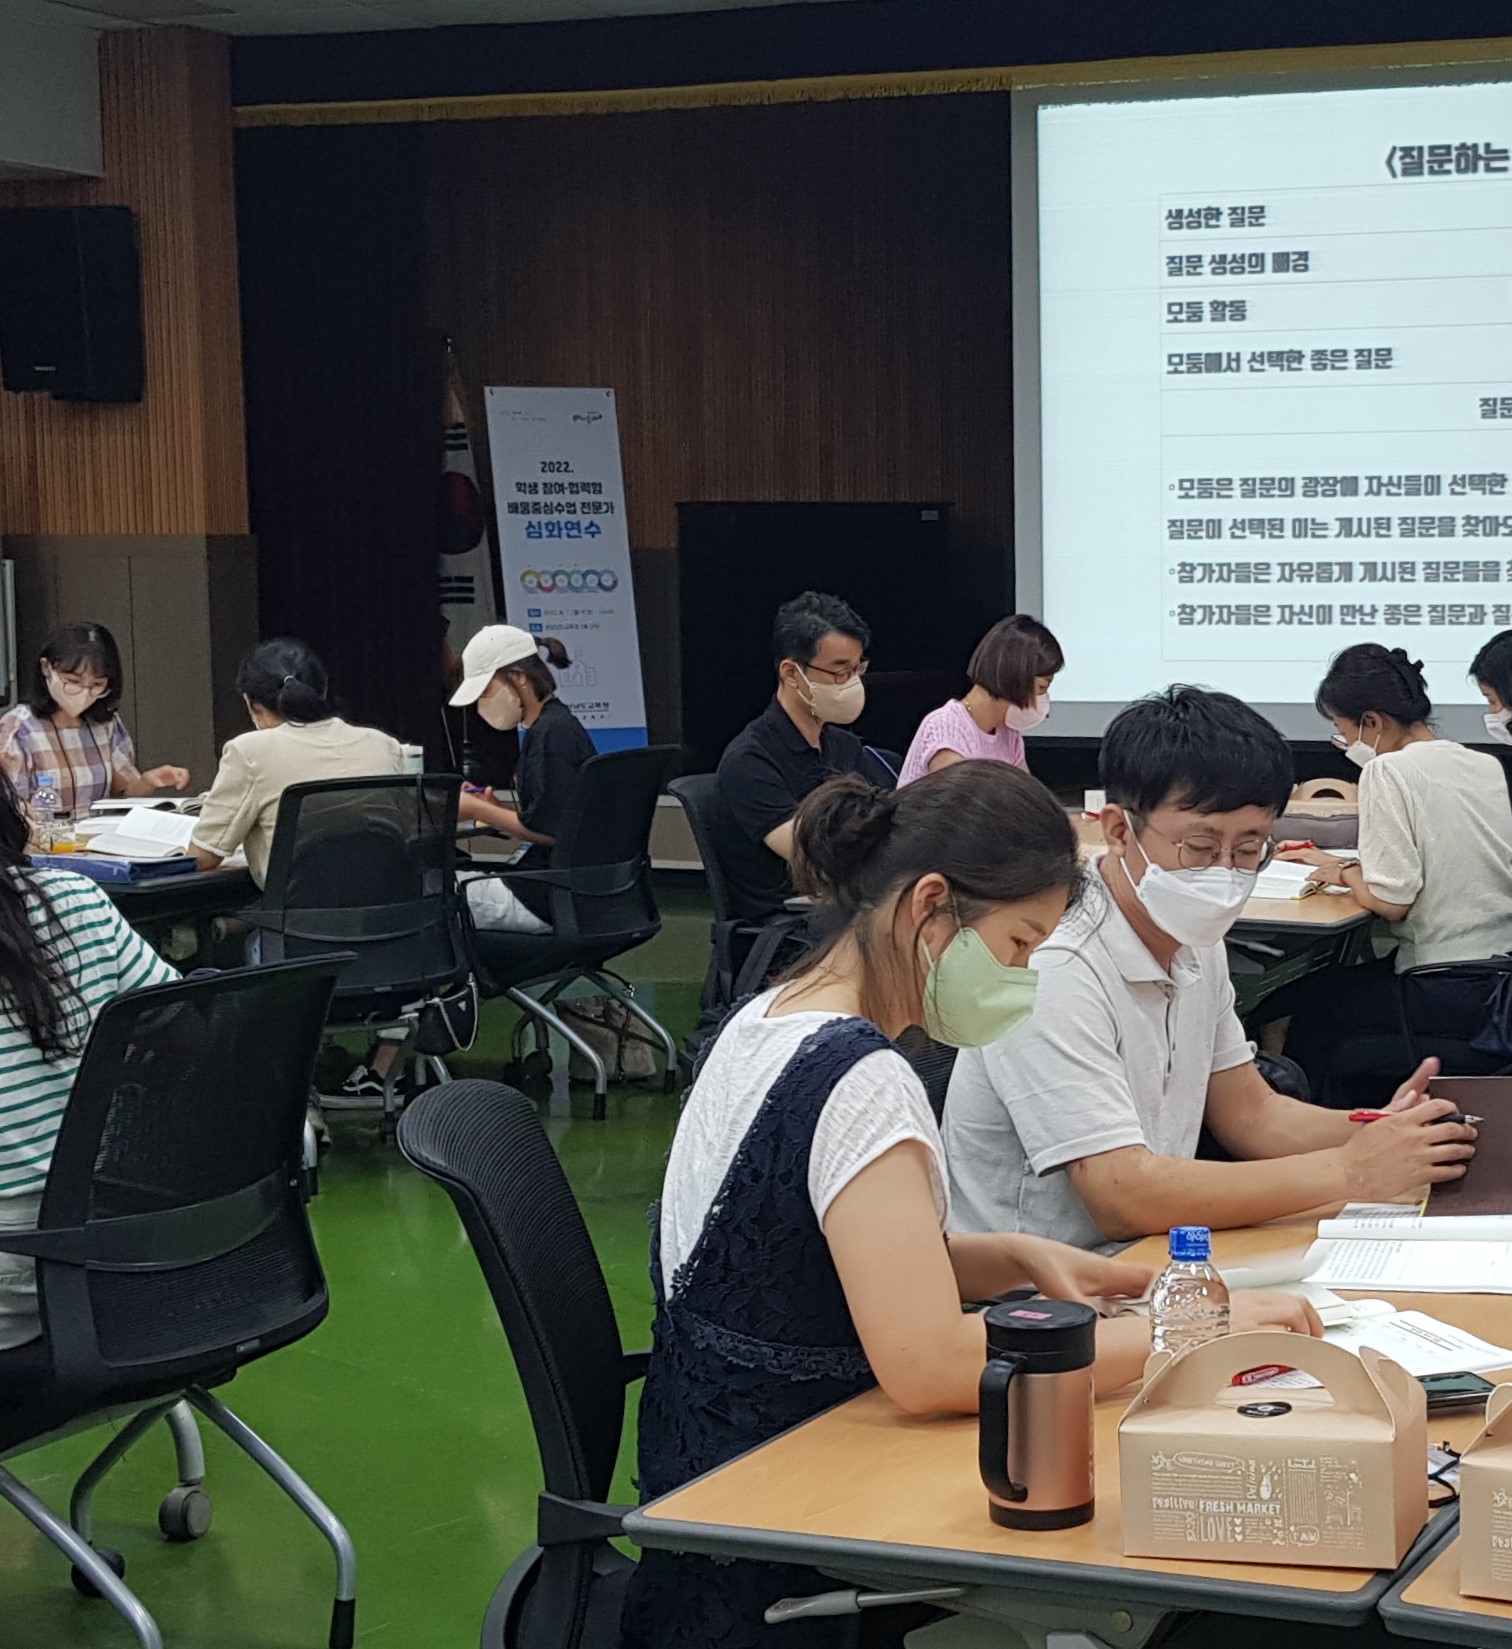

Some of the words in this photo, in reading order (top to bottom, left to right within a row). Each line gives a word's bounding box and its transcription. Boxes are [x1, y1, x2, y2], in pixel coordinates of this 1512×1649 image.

[1165, 206, 1223, 230] 생성한
[1228, 206, 1266, 227] 질문
[1167, 255, 1203, 276] 질문
[1209, 253, 1265, 275] 생성의
[1272, 251, 1309, 273] 배경
[1166, 301, 1204, 323] 모둠
[1209, 300, 1247, 322] 활동
[1167, 352, 1241, 374] 모둠에서
[1247, 349, 1305, 372] 선택한
[1310, 349, 1349, 371] 좋은
[1354, 348, 1393, 369] 질문
[540, 461, 574, 473] 2022.
[515, 482, 538, 494] 학생
[1178, 478, 1234, 499] 모둠은
[1239, 477, 1295, 498] 질문의
[1302, 476, 1359, 498] 광장에
[1365, 475, 1441, 496] 자신들이
[1448, 473, 1508, 495] 선택한
[580, 502, 614, 514] 전문가
[525, 521, 602, 539] 심화연수
[1168, 519, 1222, 539] 질문이
[1229, 518, 1285, 539] 선택된
[1292, 518, 1329, 538] 이는
[1335, 517, 1392, 538] 게시된
[1398, 516, 1456, 538] 질문을
[1178, 562, 1272, 583] 참가자들은
[1277, 562, 1353, 583] 자유롭게
[1359, 561, 1416, 582] 게시된
[1423, 561, 1501, 582] 질문들을
[1178, 604, 1272, 625] 참가자들은
[1277, 604, 1333, 625] 자신이
[1340, 604, 1379, 625] 만난
[1383, 604, 1422, 625] 좋은
[1428, 604, 1487, 625] 질문과
[1200, 1501, 1233, 1513] FRESH
[1237, 1502, 1280, 1514] MARKET
[1200, 1516, 1234, 1542] LOVE
